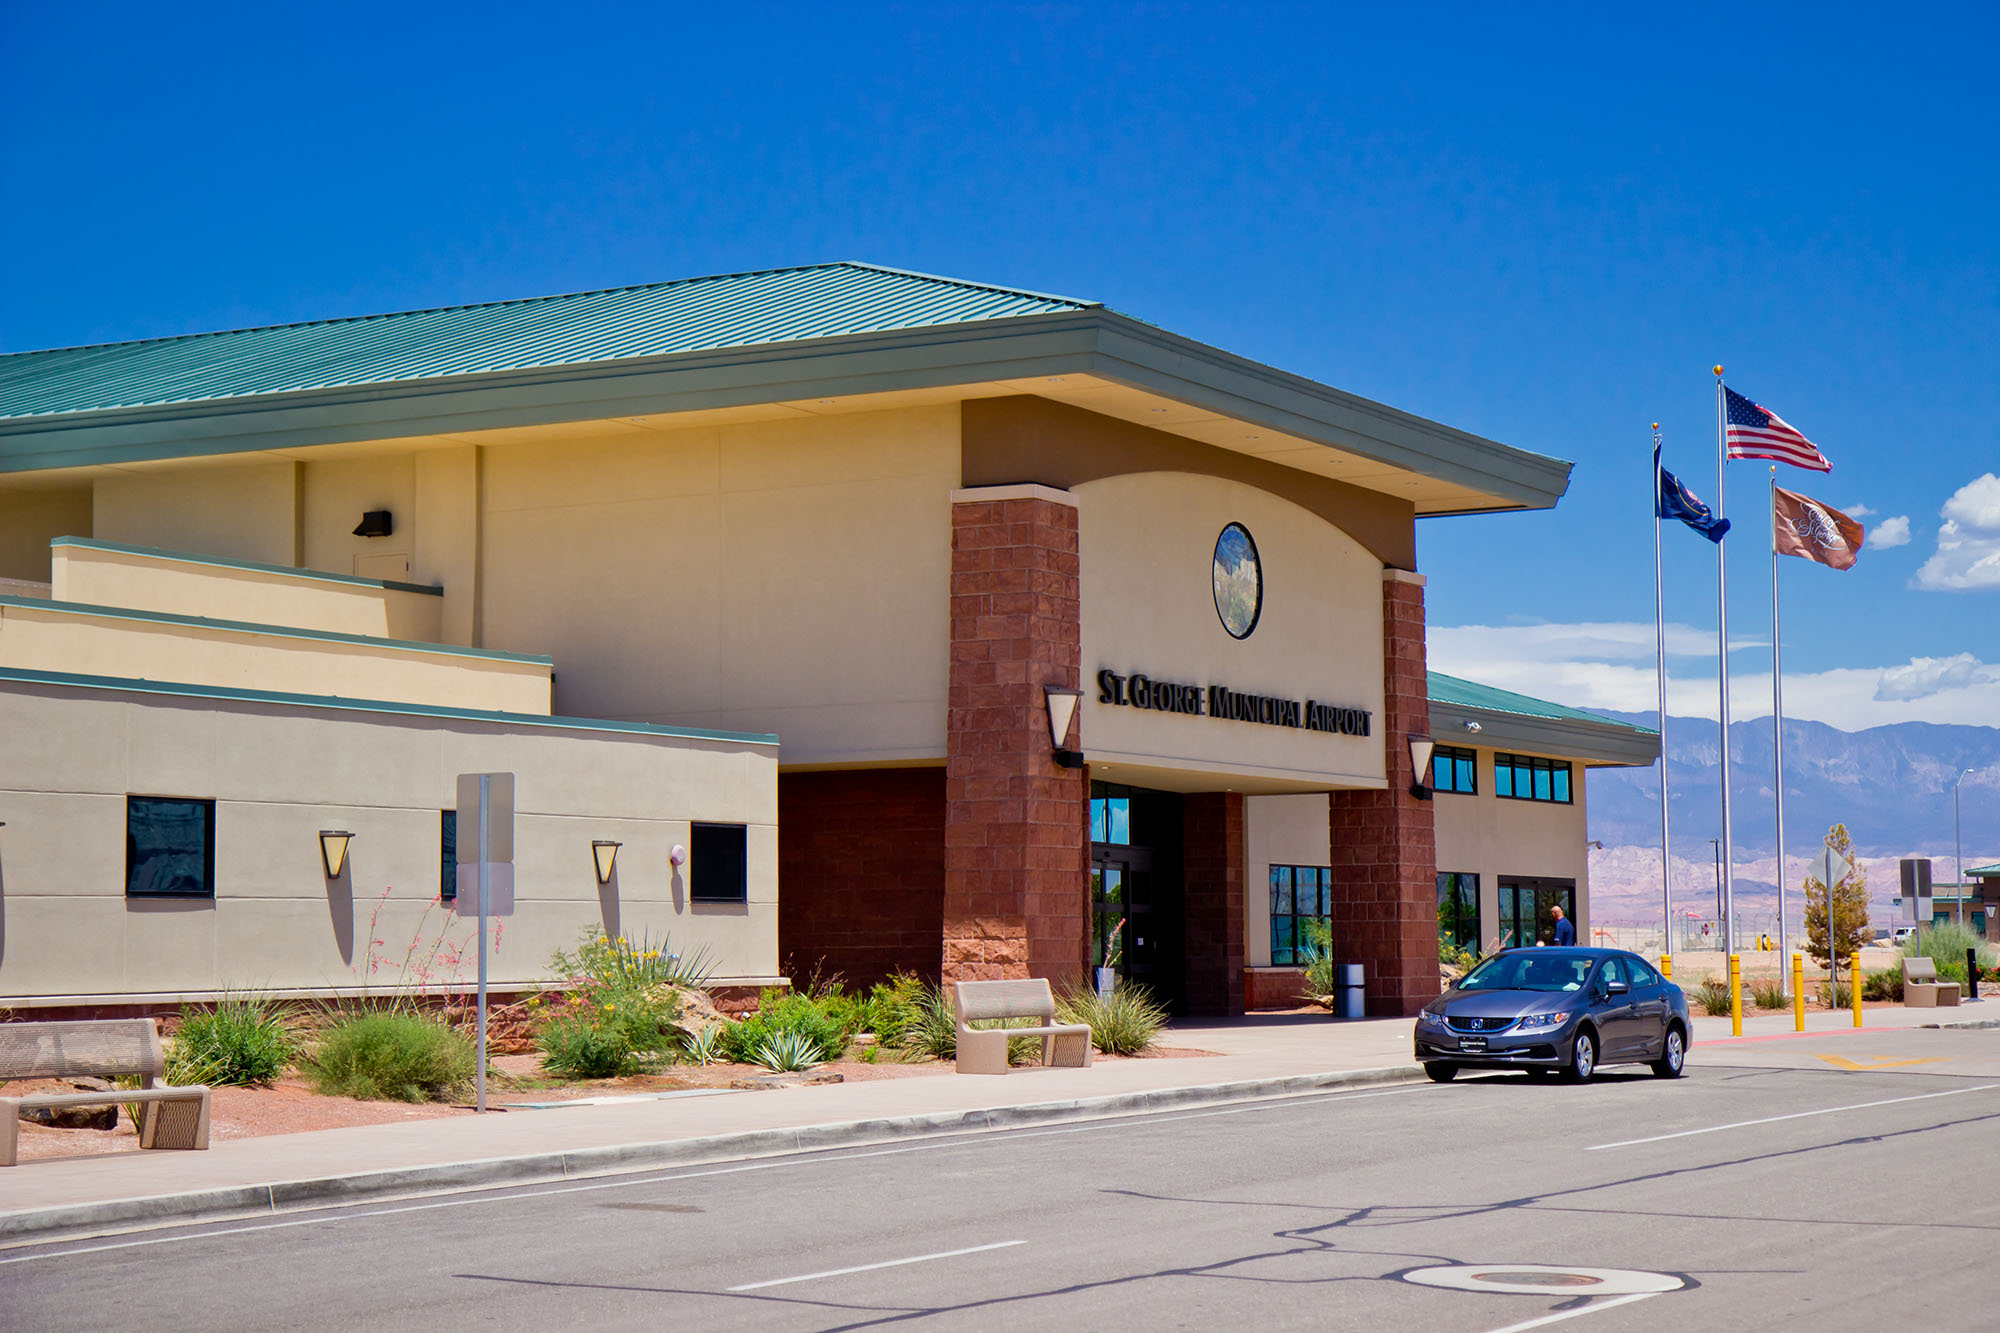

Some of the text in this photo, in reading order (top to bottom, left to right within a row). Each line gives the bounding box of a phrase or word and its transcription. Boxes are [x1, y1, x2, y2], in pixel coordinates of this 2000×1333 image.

[1129, 674, 1206, 715] GEORGE
[1209, 685, 1304, 729] MUNICIPAL
[1305, 700, 1373, 737] AIRPORT
